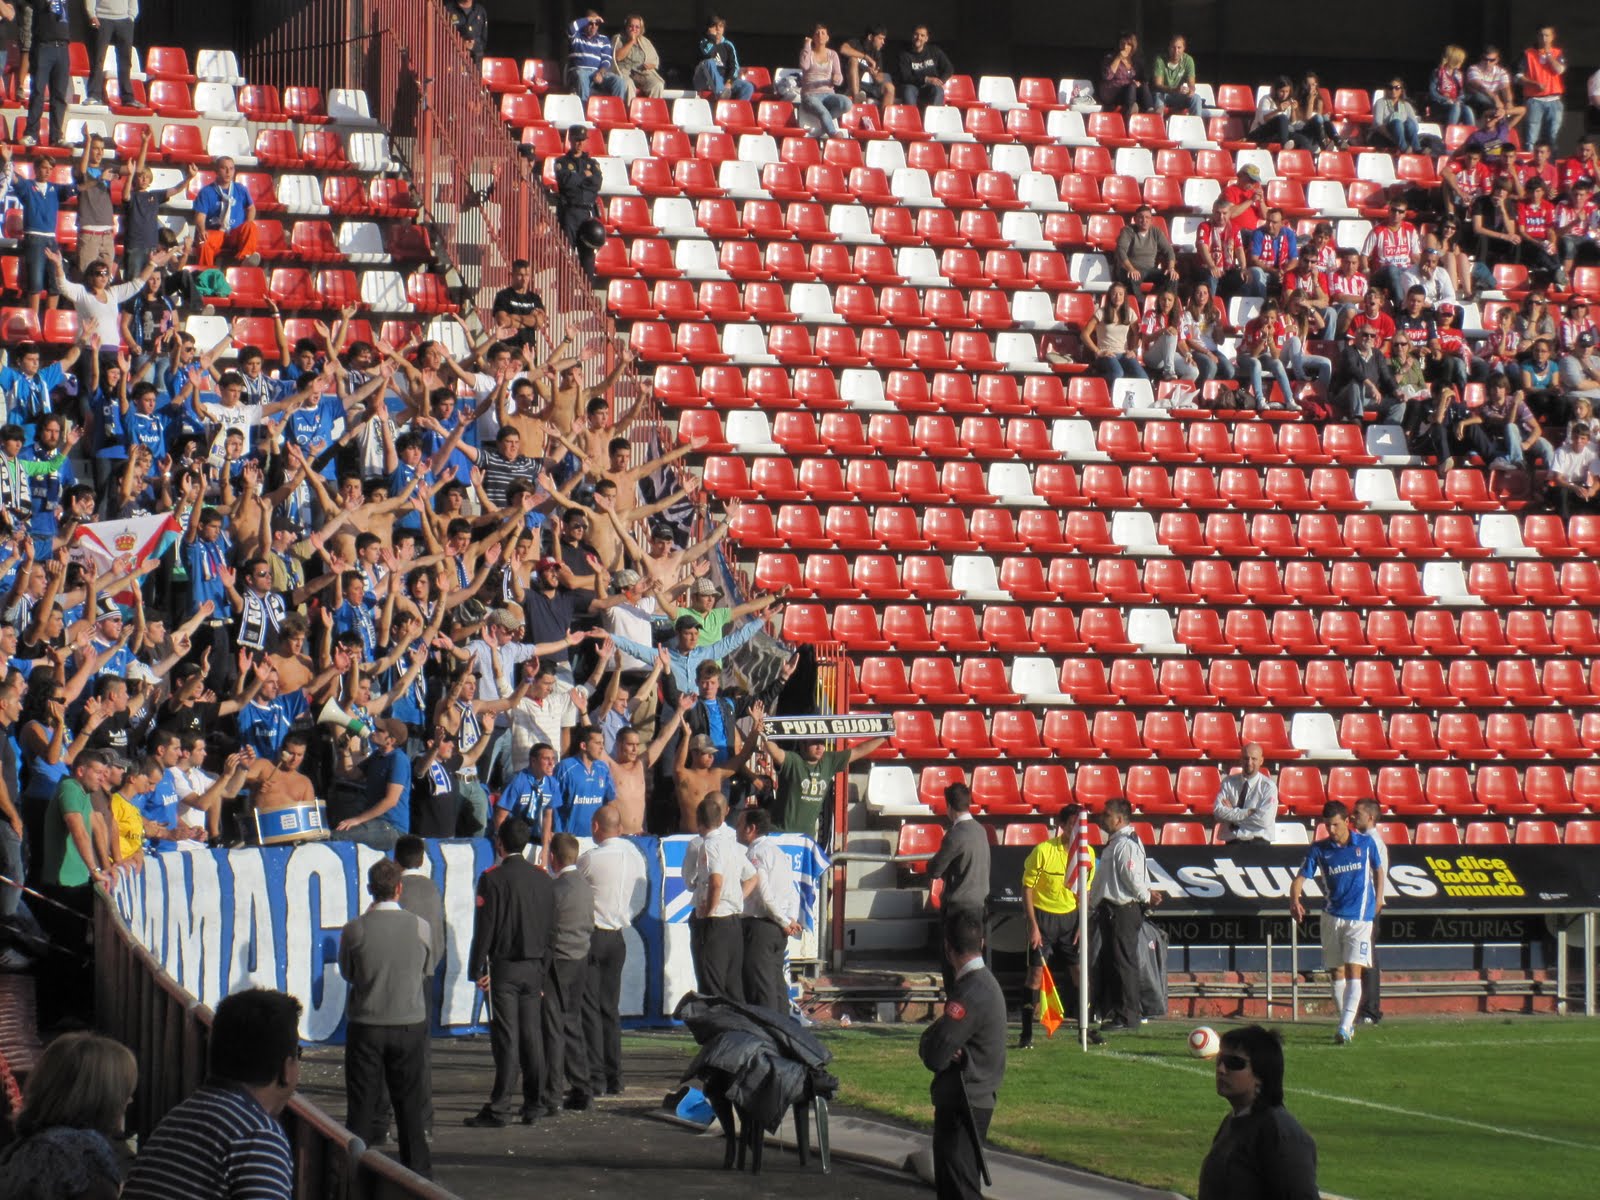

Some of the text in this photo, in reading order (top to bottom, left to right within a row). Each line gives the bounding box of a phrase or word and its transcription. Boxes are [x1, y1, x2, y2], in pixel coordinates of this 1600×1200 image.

[781, 718, 883, 735] PUTA GIJON
[573, 794, 602, 805] Asturias
[1328, 862, 1362, 875] Asturias
[1425, 856, 1508, 870] lo dice
[1434, 869, 1517, 883] todo el
[1444, 882, 1525, 897] mundo
[1210, 921, 1245, 940] DEL
[1391, 920, 1417, 939] DE
[1431, 917, 1525, 938] ASTURIAS
[847, 928, 856, 946] 1
